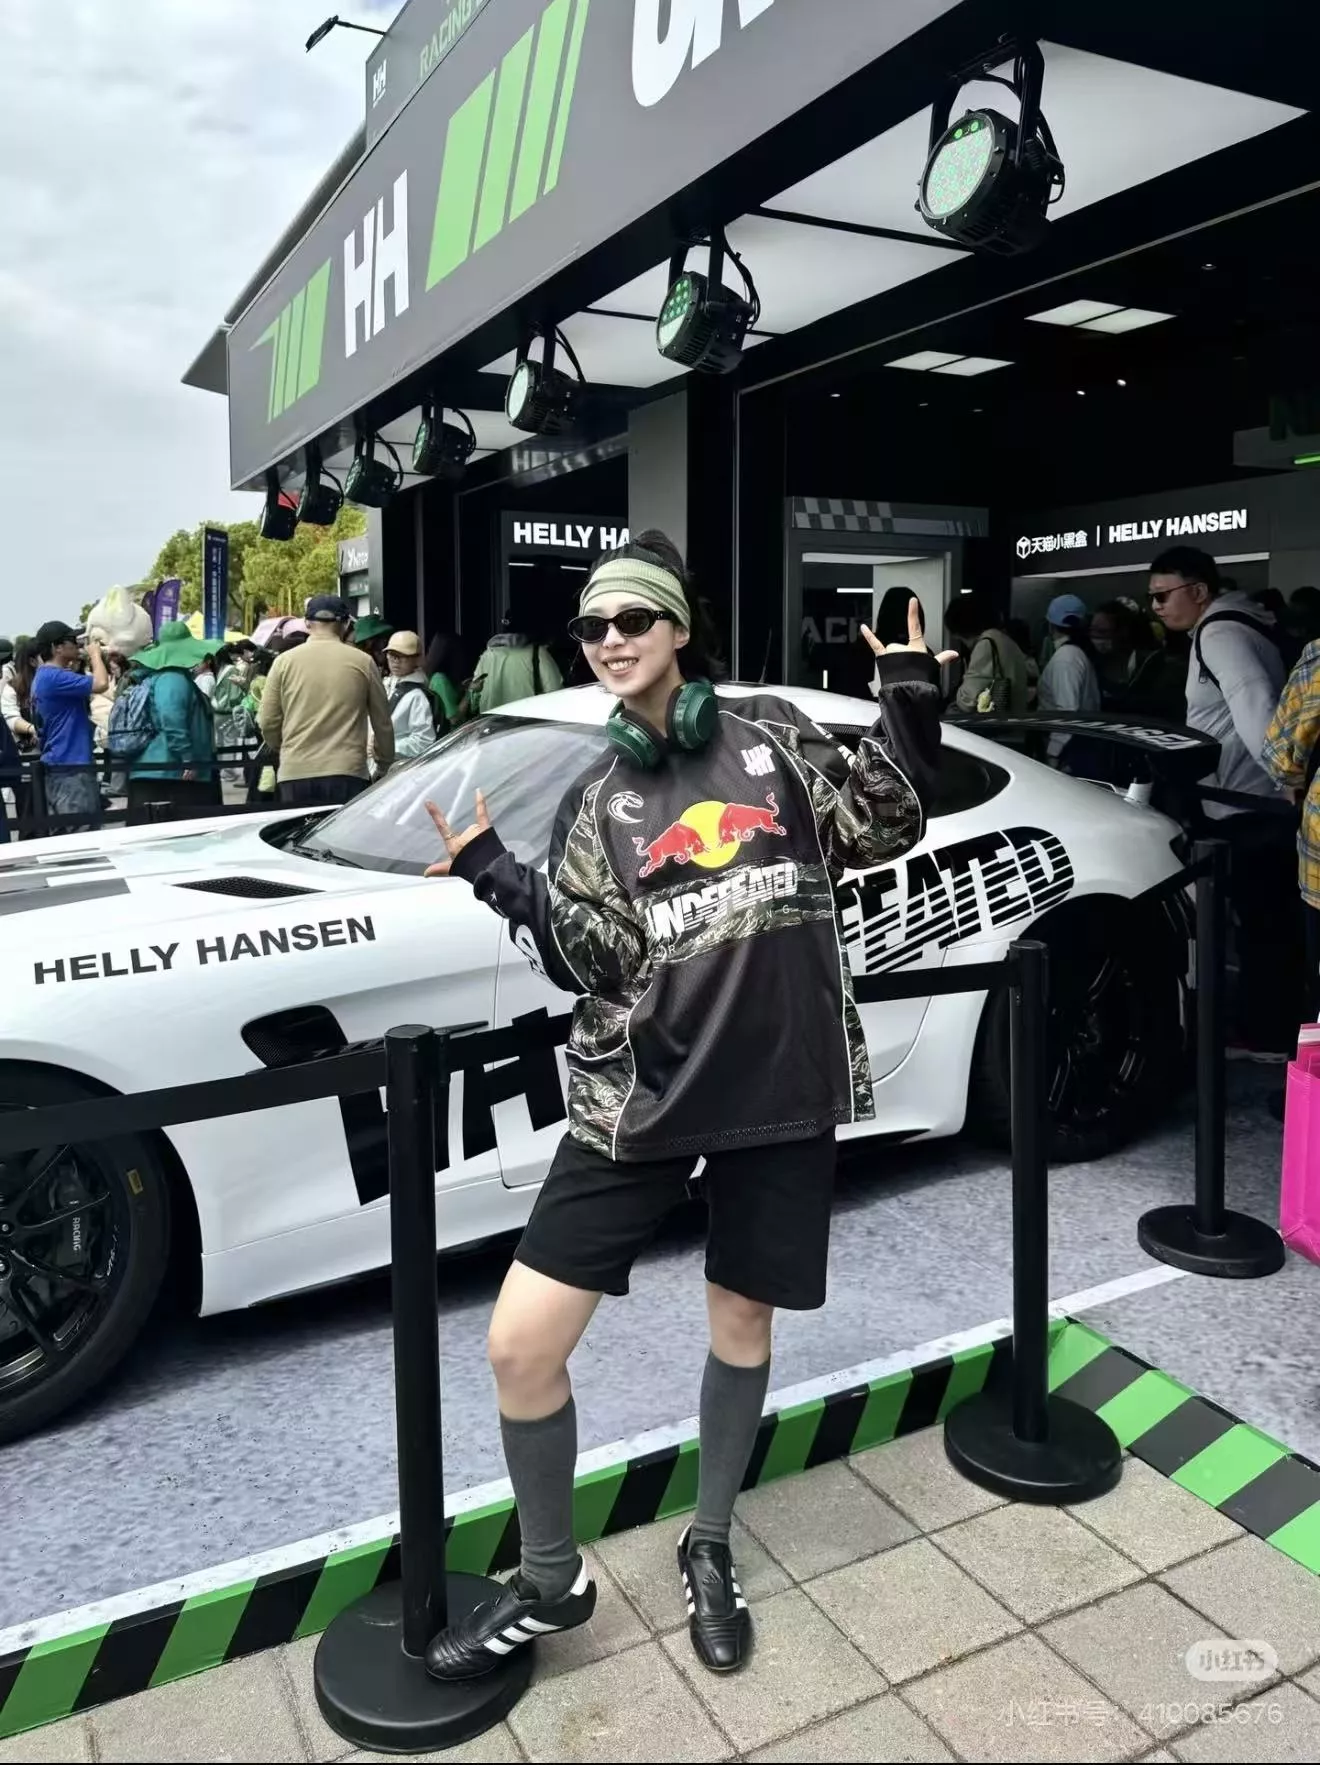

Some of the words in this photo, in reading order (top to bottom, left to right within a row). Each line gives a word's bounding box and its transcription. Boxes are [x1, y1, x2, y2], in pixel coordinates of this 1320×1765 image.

[343, 169, 409, 359] HH
[513, 521, 594, 549] HELLY
[1031, 530, 1088, 554] 天猫小黑盒
[1108, 519, 1163, 544] HELLY
[1165, 508, 1248, 537] HANSEN
[34, 942, 180, 985] HELLY
[196, 915, 377, 965] HANSEN
